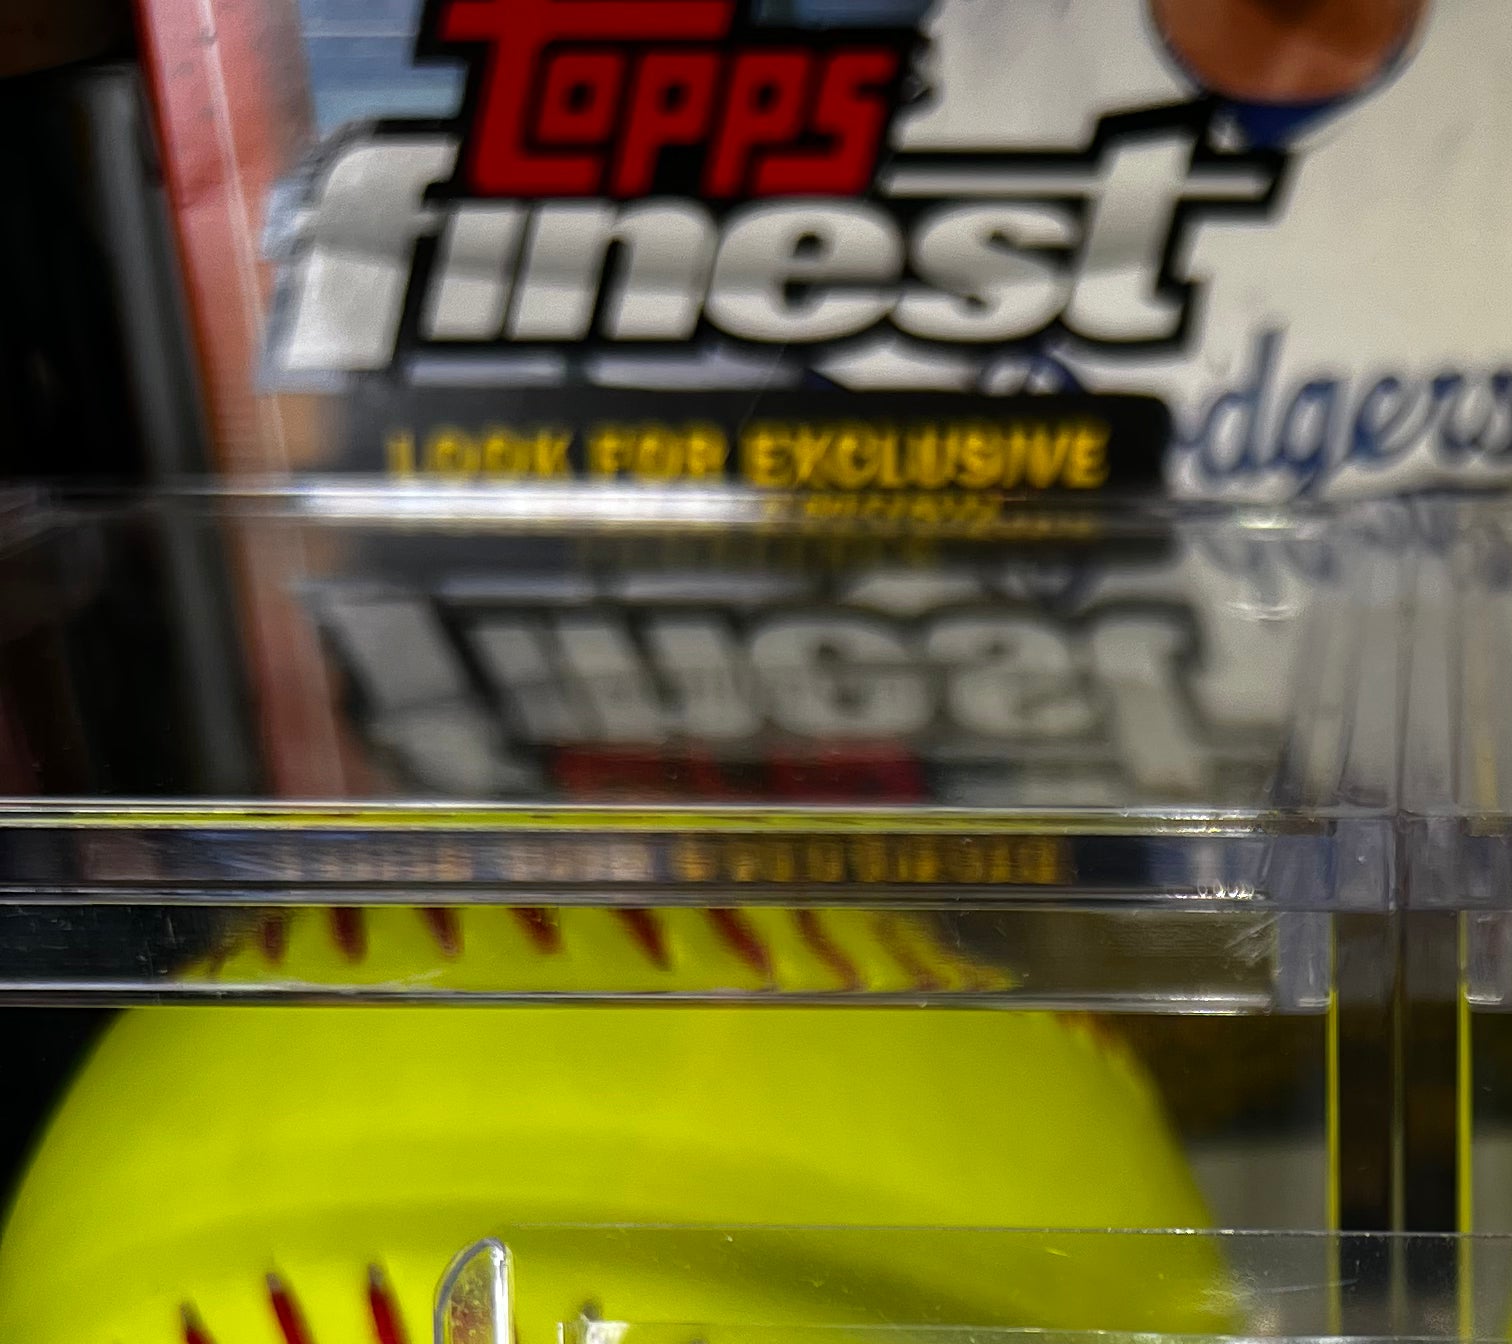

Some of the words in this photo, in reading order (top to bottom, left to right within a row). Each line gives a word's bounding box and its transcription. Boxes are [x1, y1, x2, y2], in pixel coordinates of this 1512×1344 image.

[278, 130, 1280, 373] finest
[383, 424, 572, 484] LOOK
[588, 424, 728, 484] FOR
[742, 418, 1112, 490] EXCLUSIVE
